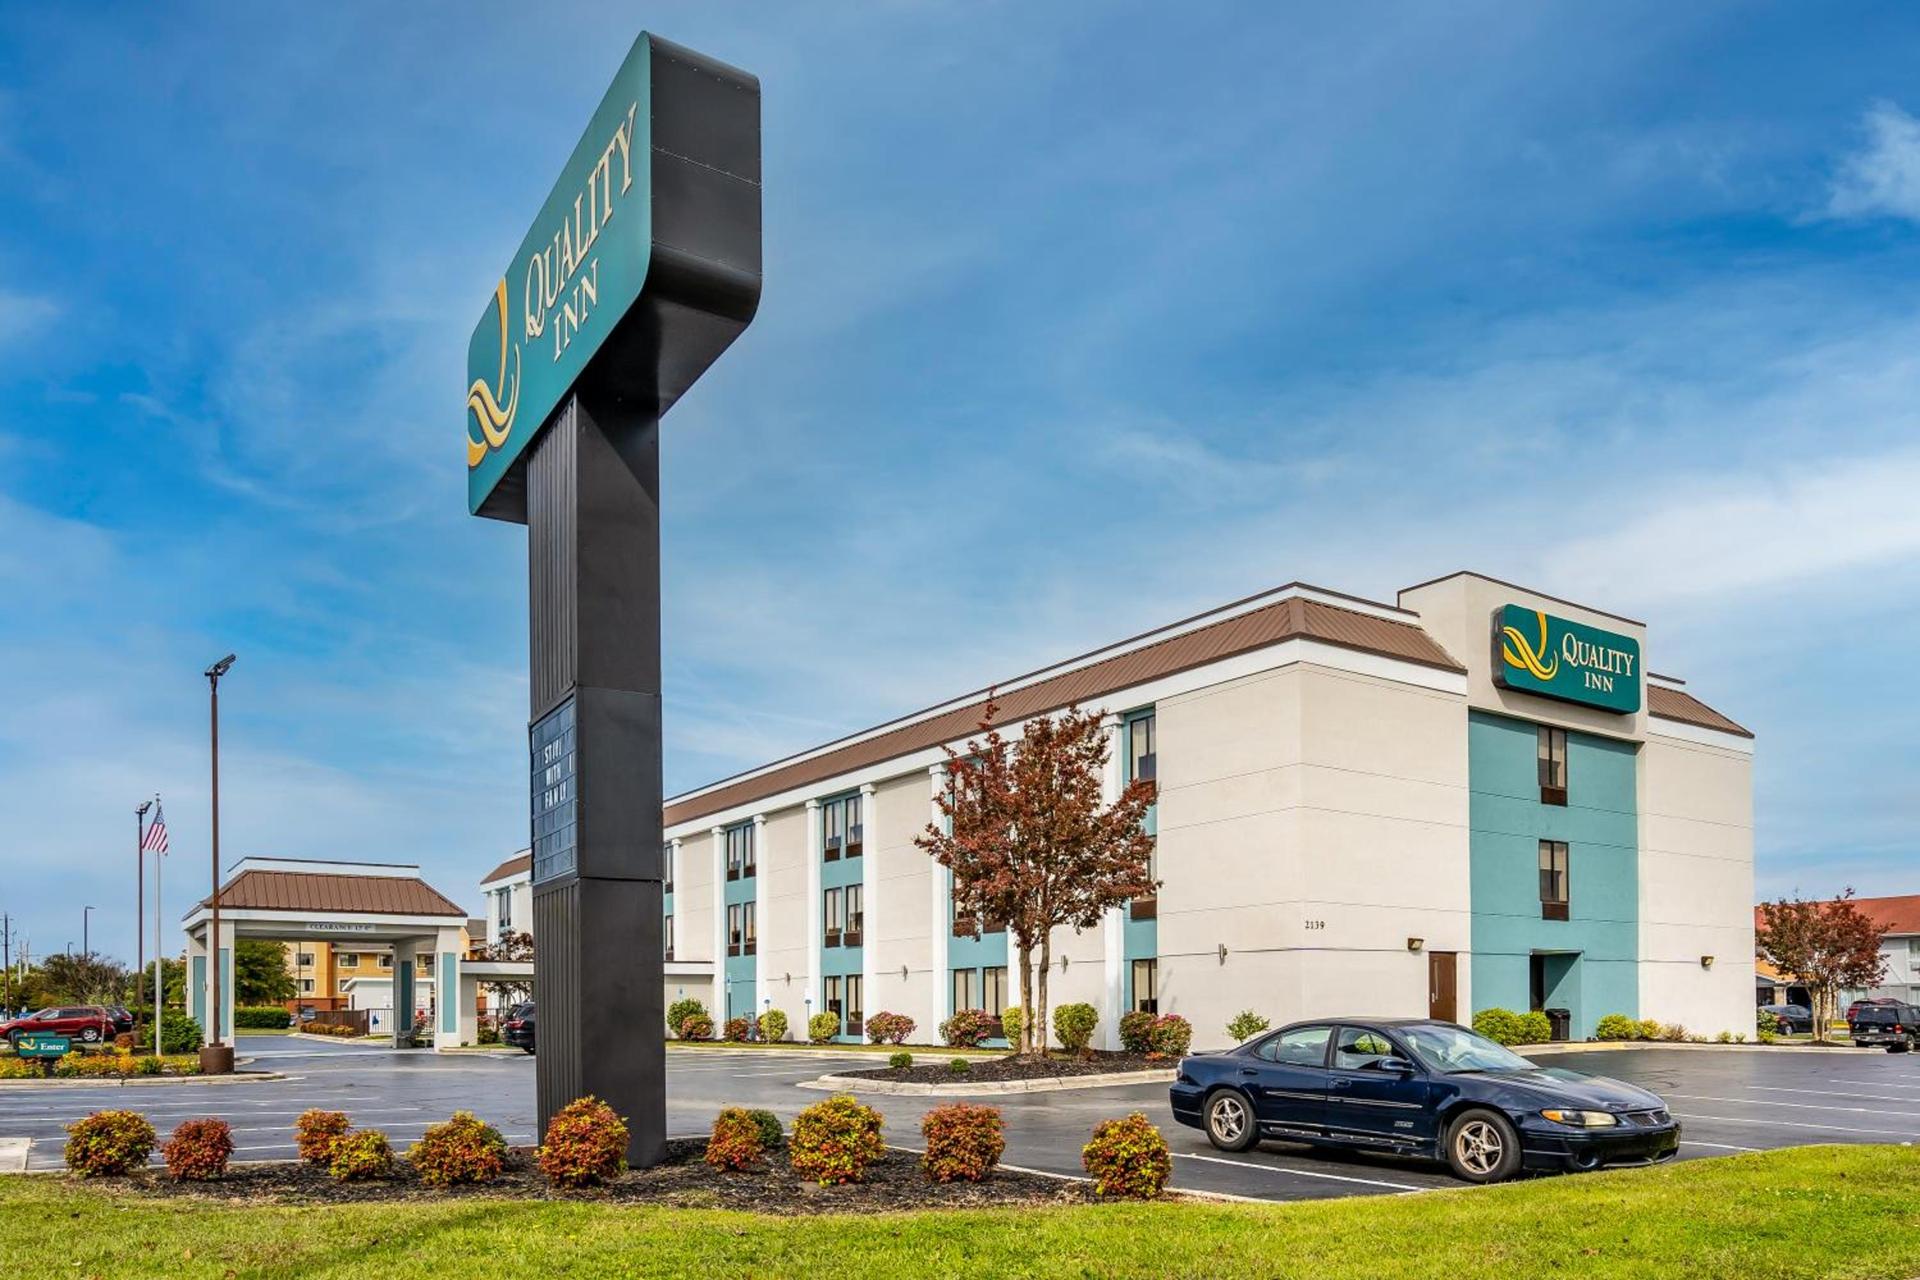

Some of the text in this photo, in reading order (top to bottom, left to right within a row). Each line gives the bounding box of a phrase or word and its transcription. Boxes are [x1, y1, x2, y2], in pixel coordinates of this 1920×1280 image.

[525, 101, 638, 345] QUALITY
[553, 257, 599, 363] INN
[1562, 632, 1634, 677] QUALITY
[1584, 671, 1614, 693] INN
[40, 1042, 66, 1051] Enter
